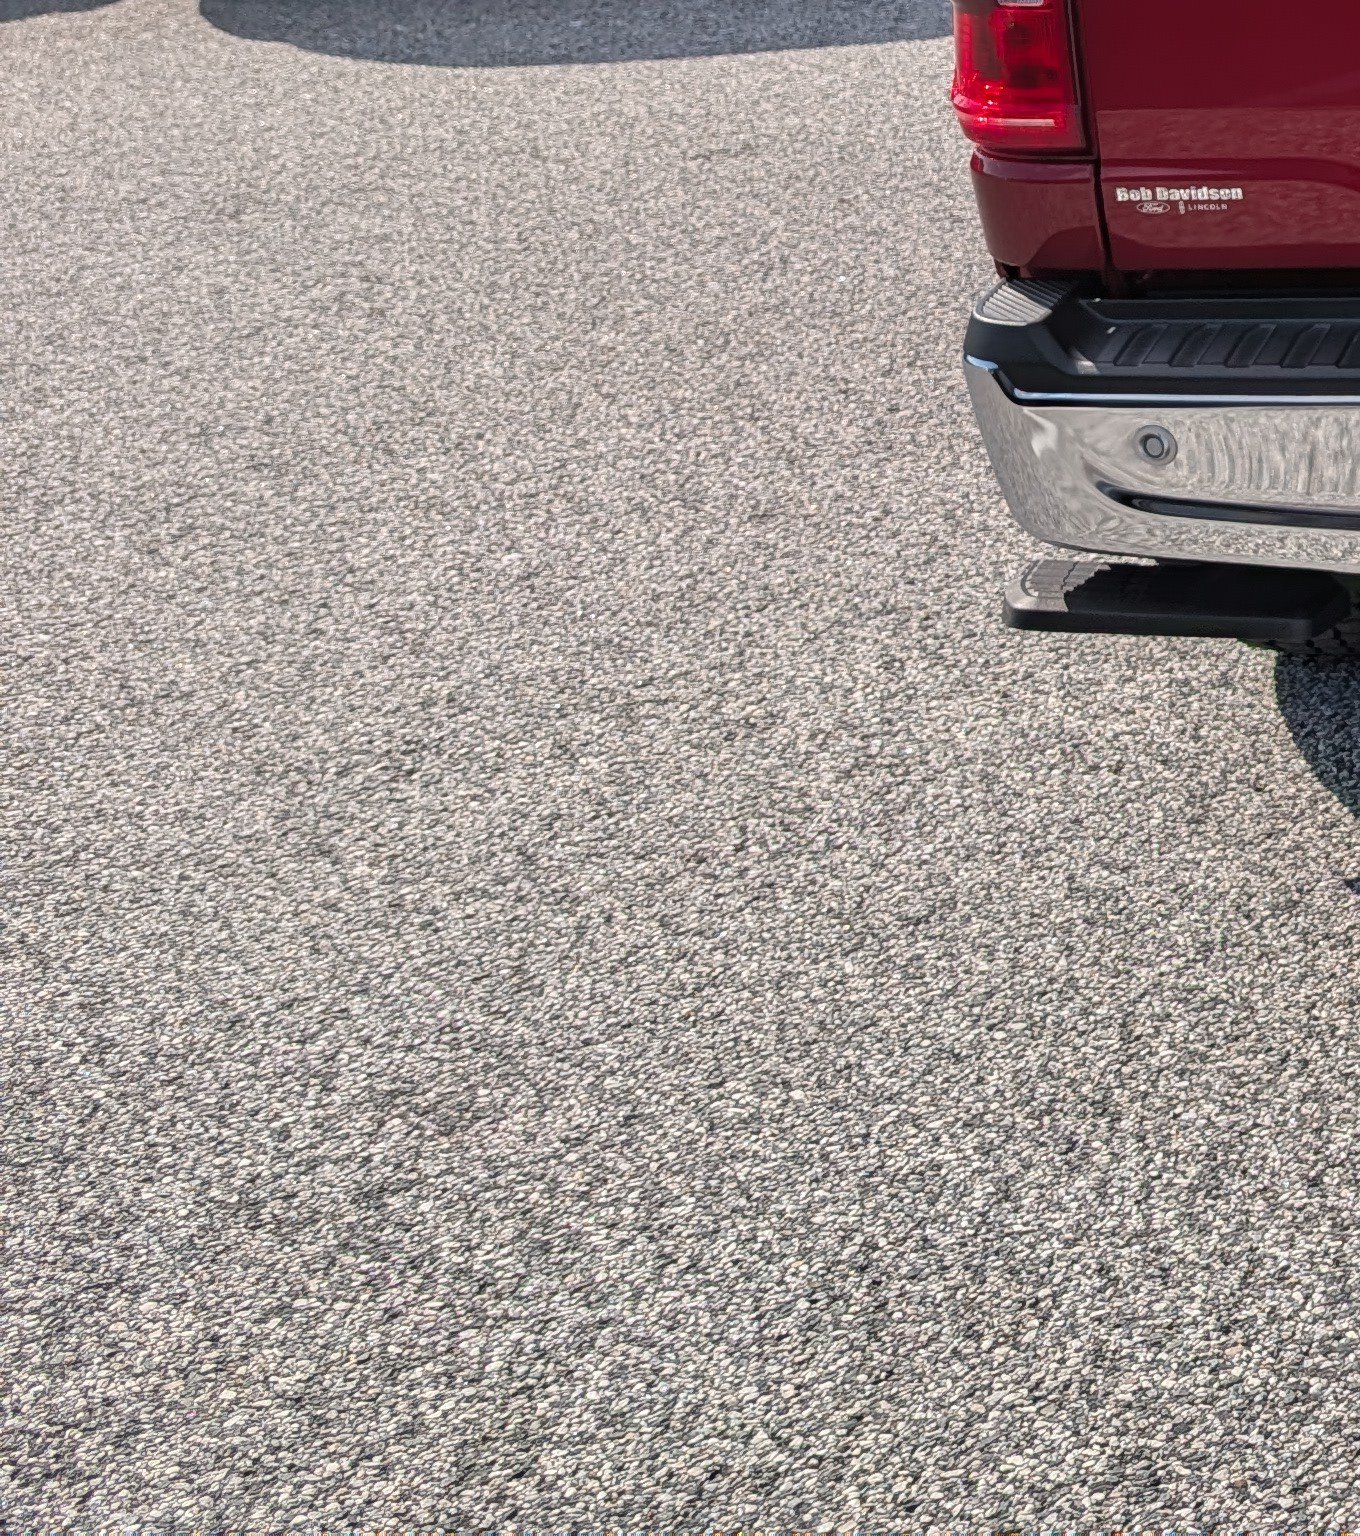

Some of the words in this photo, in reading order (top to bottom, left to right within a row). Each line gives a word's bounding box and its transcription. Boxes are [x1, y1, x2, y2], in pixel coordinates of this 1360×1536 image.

[1115, 187, 1152, 202] Bob
[1155, 186, 1244, 201] Davidson
[1188, 203, 1228, 211] LINCOLN
